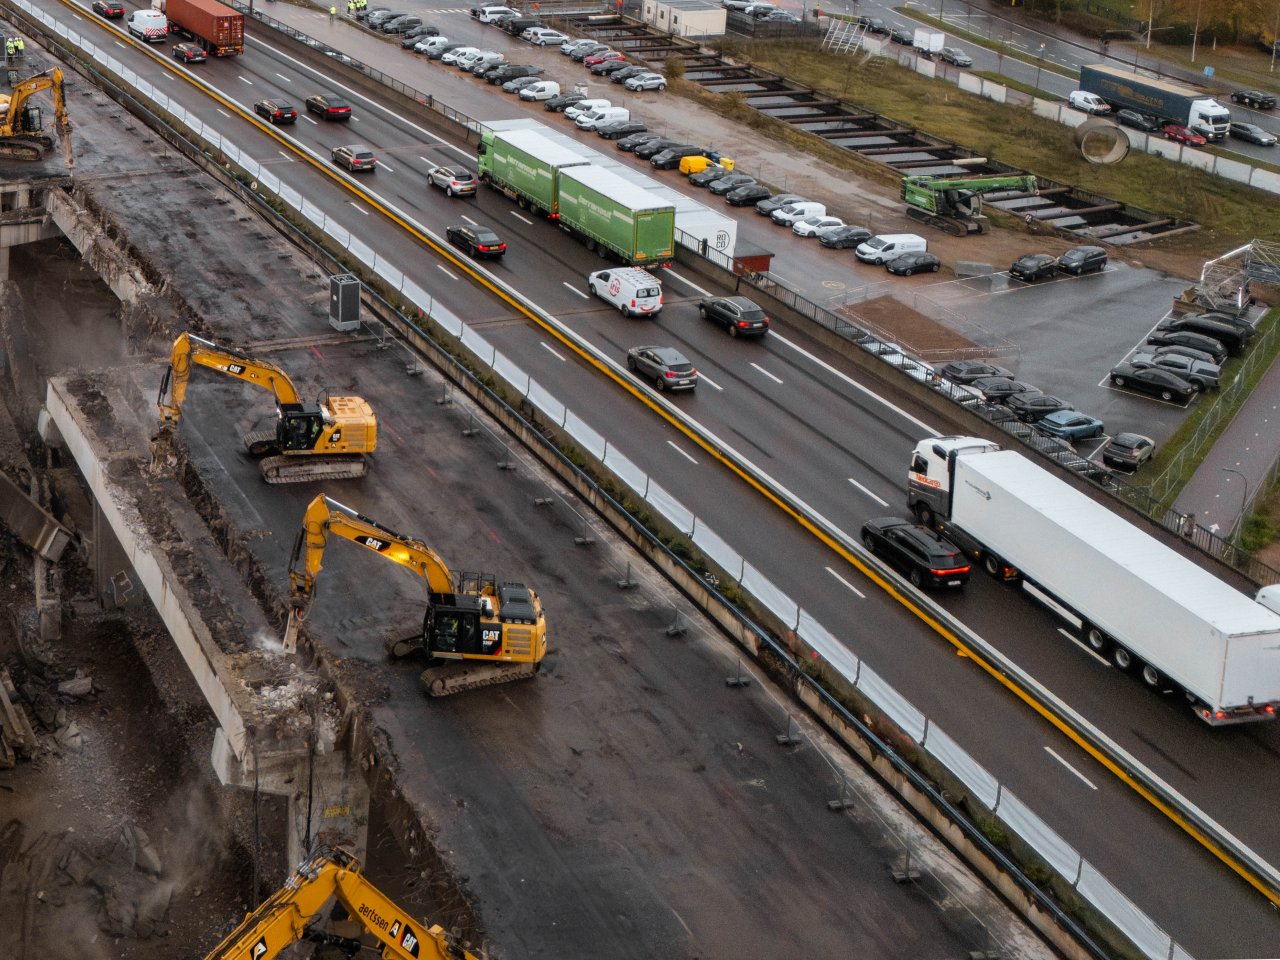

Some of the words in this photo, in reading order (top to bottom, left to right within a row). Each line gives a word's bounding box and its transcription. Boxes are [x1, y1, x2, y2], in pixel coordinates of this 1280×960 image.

[229, 365, 241, 373] CAT
[365, 537, 382, 550] CAT
[482, 629, 500, 641] CAT
[358, 903, 389, 932] aertssen
[402, 933, 418, 953] CAT
